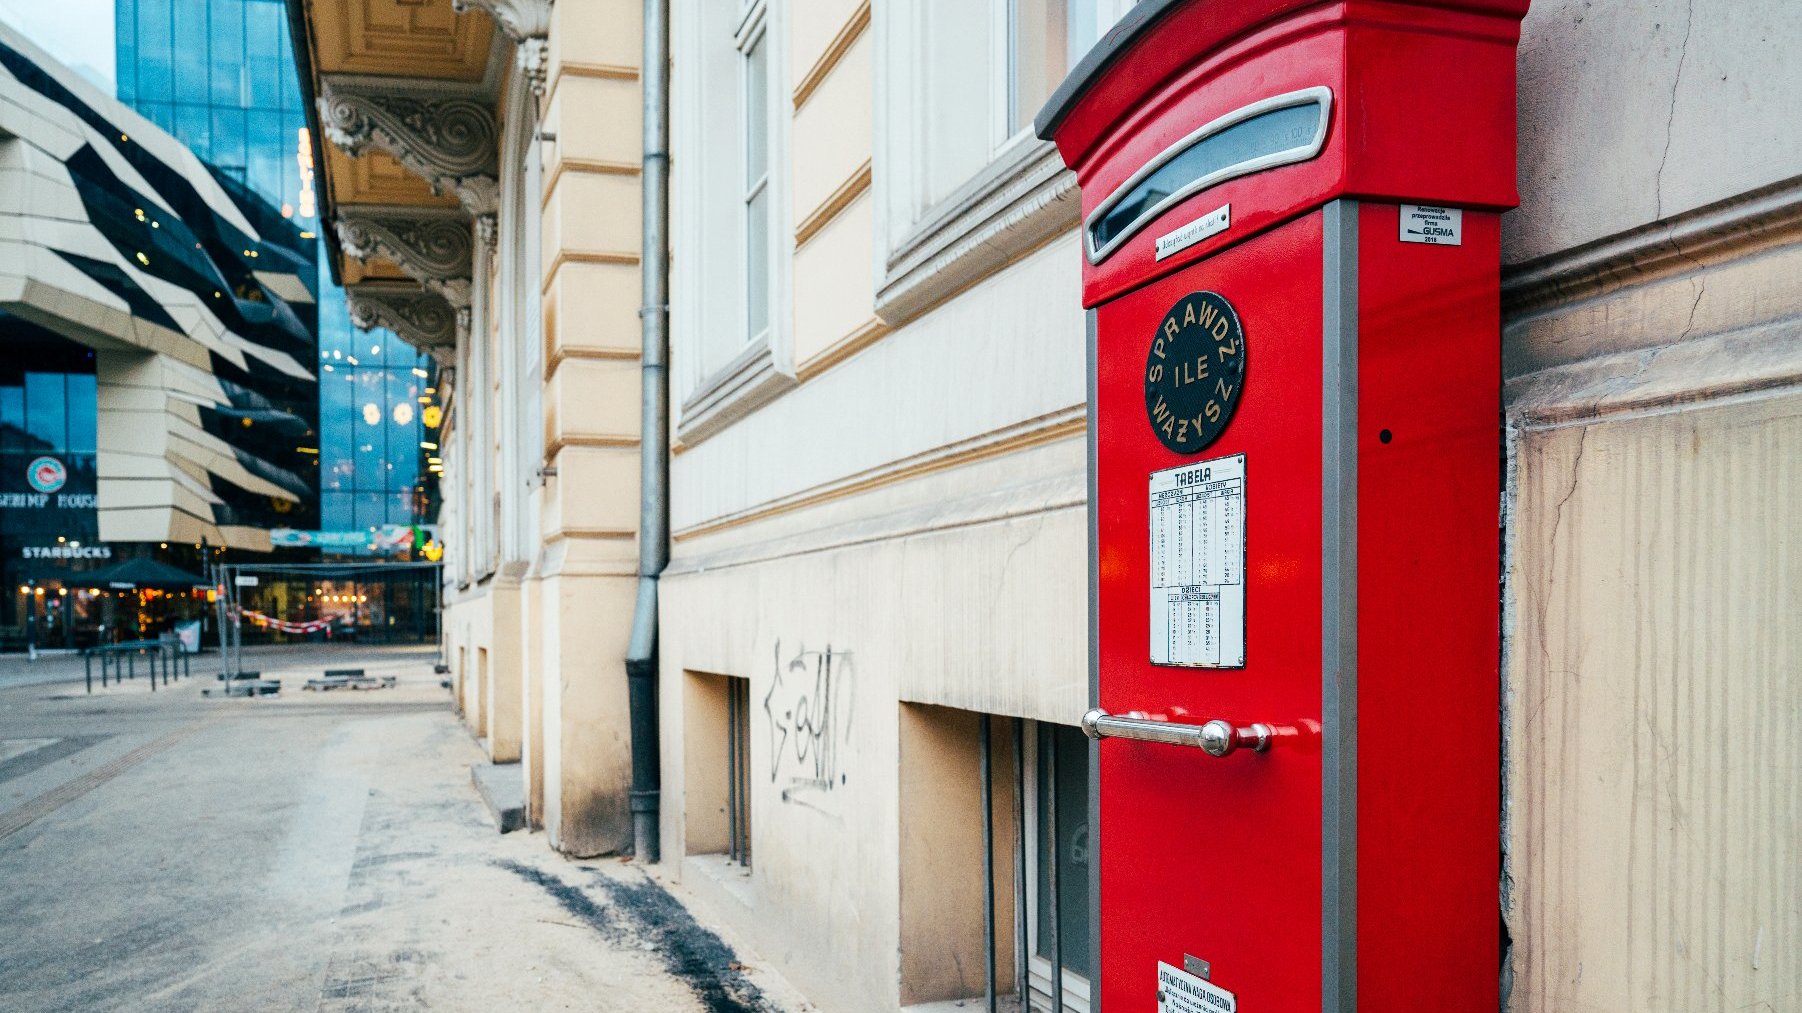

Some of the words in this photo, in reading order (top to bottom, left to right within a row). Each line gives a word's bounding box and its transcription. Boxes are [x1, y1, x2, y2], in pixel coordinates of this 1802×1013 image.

[1423, 227, 1454, 237] GUSMA
[1174, 354, 1209, 388] ILE
[1174, 467, 1211, 487] TABELA
[22, 546, 112, 559] STARBUCKS
[1181, 586, 1201, 594] DZIECI
